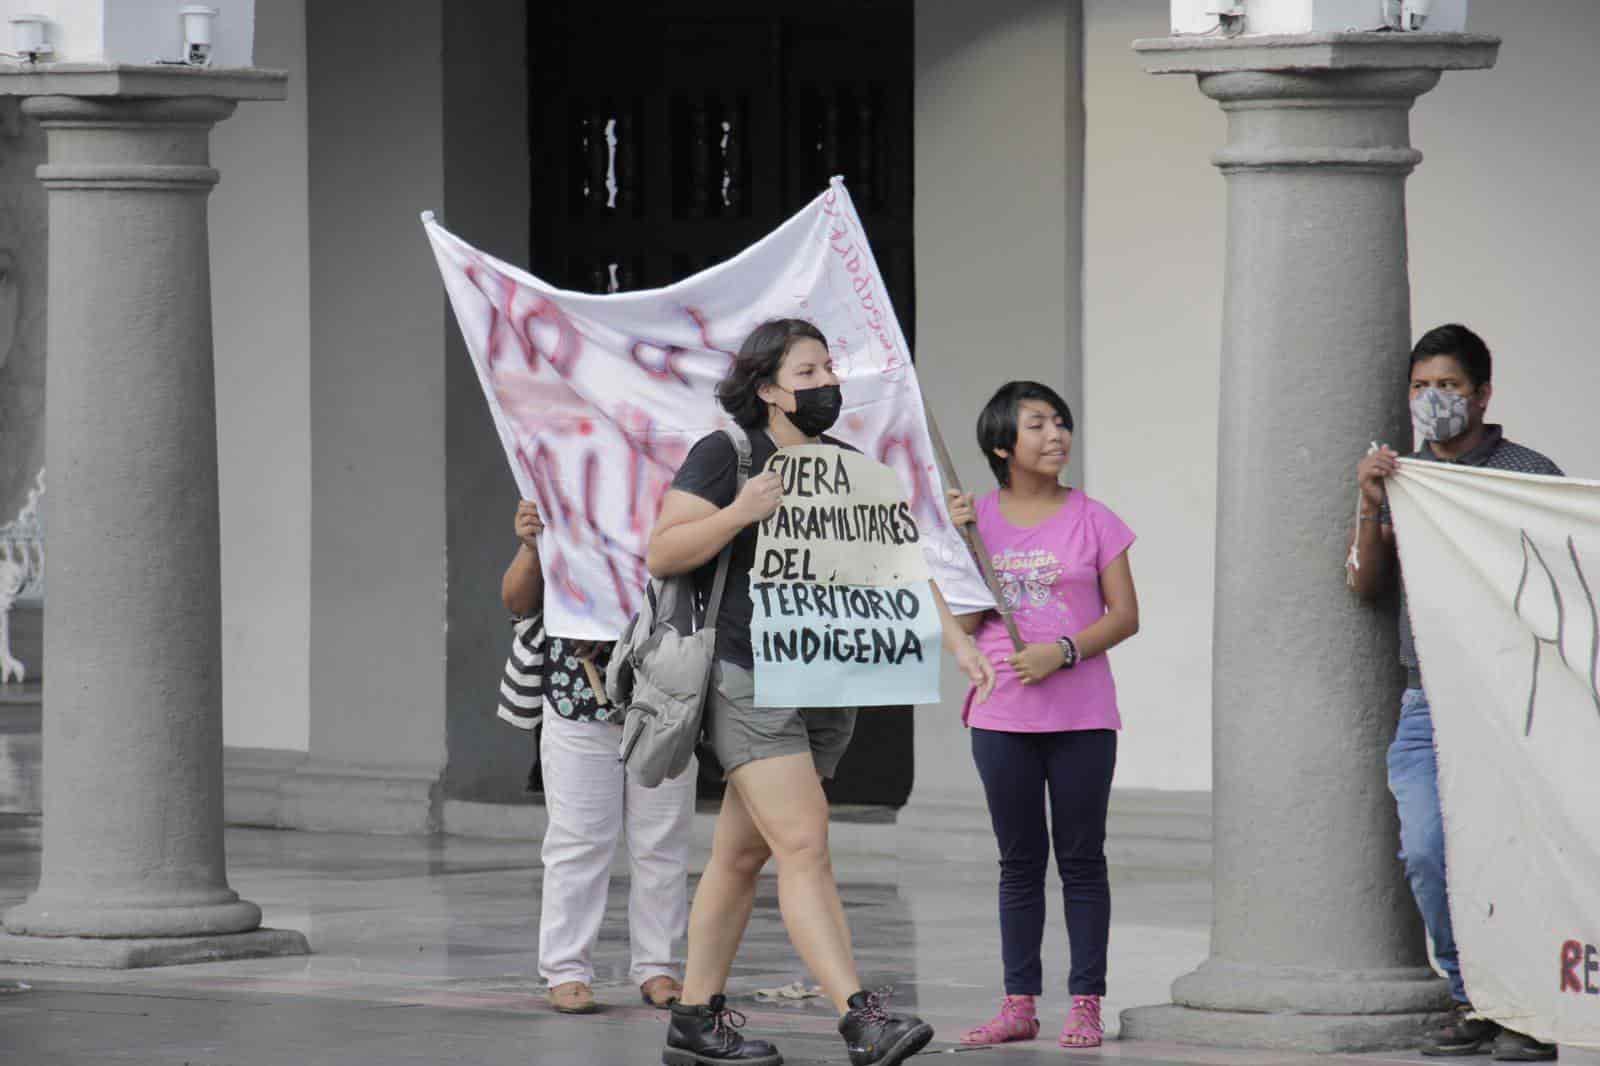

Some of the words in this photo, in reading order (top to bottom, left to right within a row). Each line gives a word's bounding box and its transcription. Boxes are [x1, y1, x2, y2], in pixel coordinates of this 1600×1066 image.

[768, 453, 851, 496] FUERA
[760, 548, 817, 581] DEL
[762, 624, 923, 665] INDÍGENA
